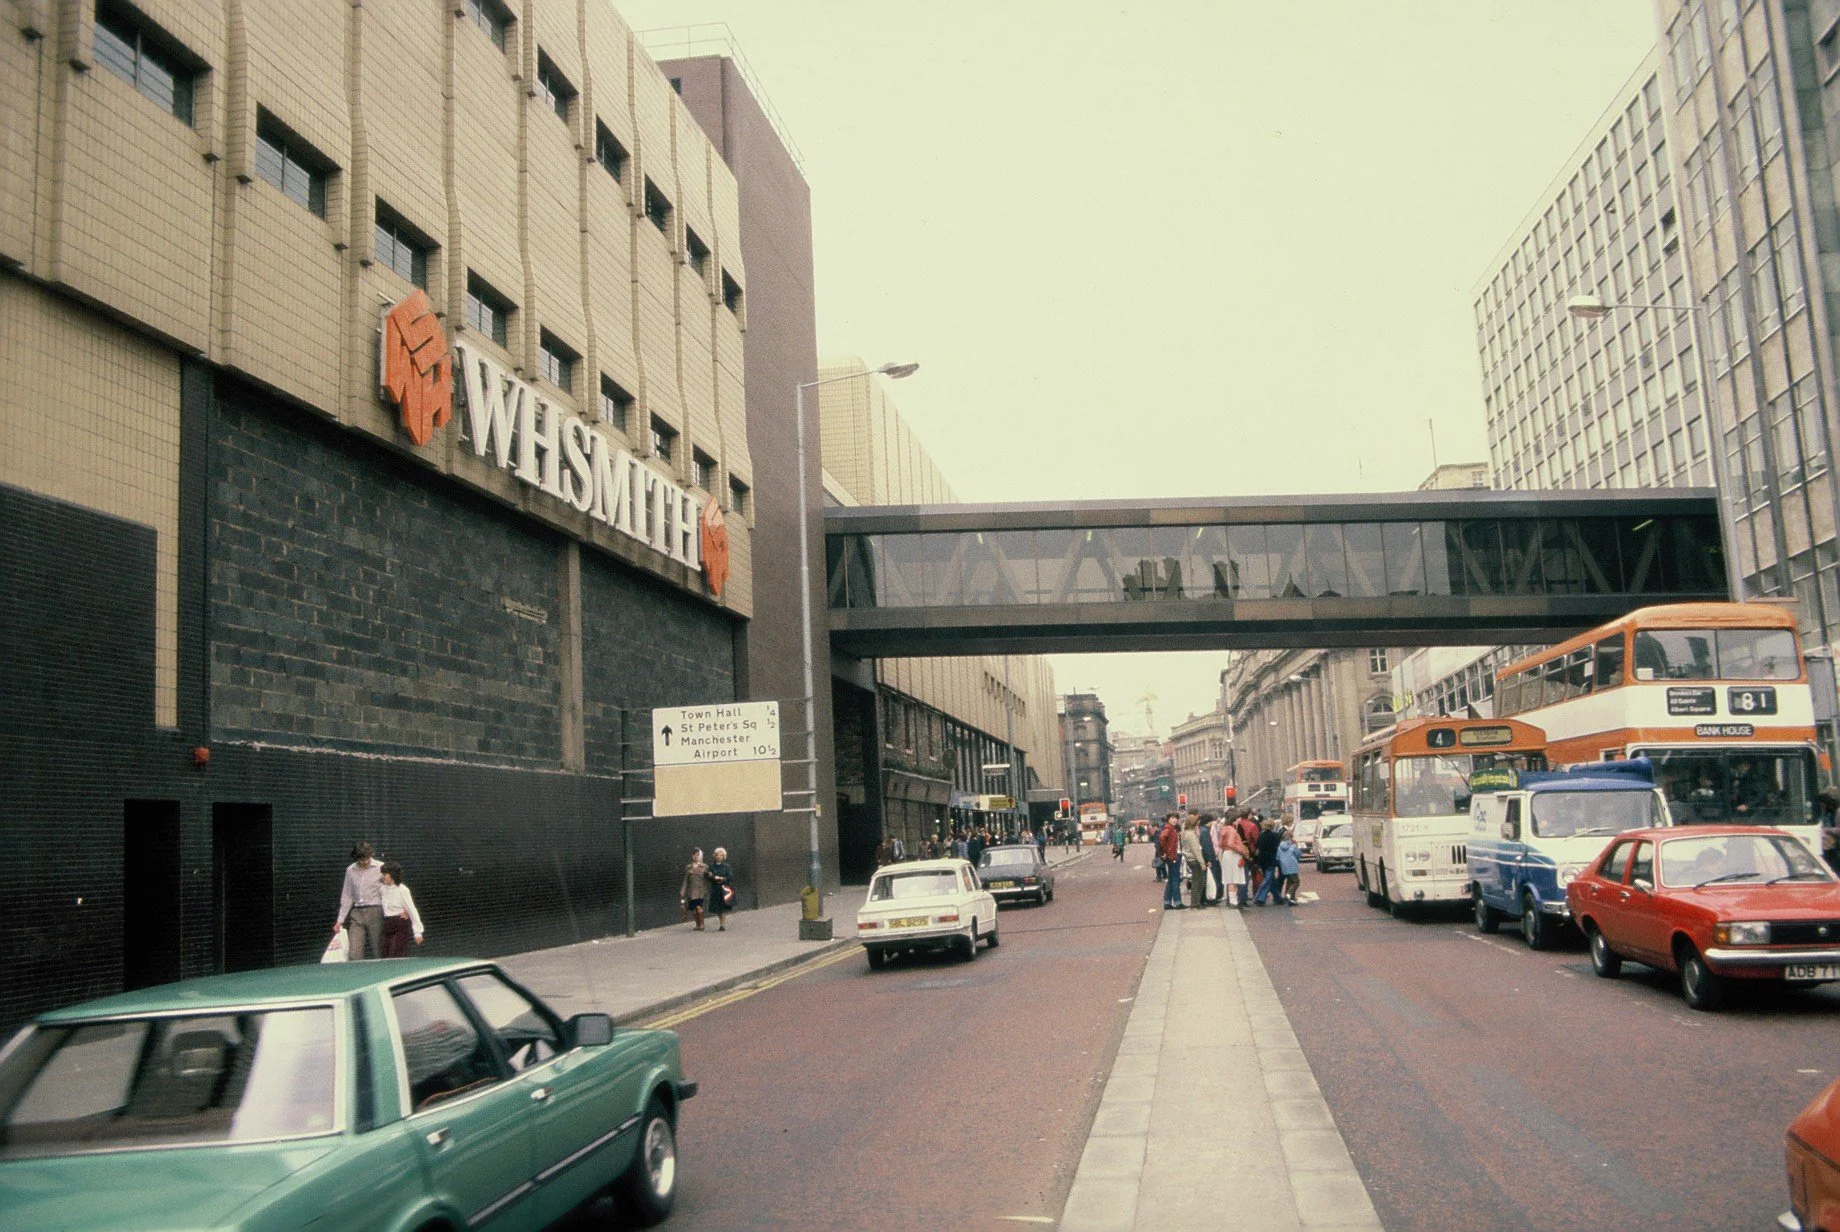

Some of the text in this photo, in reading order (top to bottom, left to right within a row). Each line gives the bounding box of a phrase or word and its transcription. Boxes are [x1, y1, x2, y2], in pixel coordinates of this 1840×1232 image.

[455, 339, 703, 572] WHSMITH
[681, 710, 712, 720] Town
[716, 707, 742, 718] Hall
[681, 723, 693, 733] St
[698, 721, 738, 732] Peter's
[742, 719, 757, 731] Sq
[1696, 725, 1752, 736] BANK HOUSE
[681, 734, 750, 746] Manchester
[1435, 732, 1443, 746] 4
[693, 747, 738, 759] Airport
